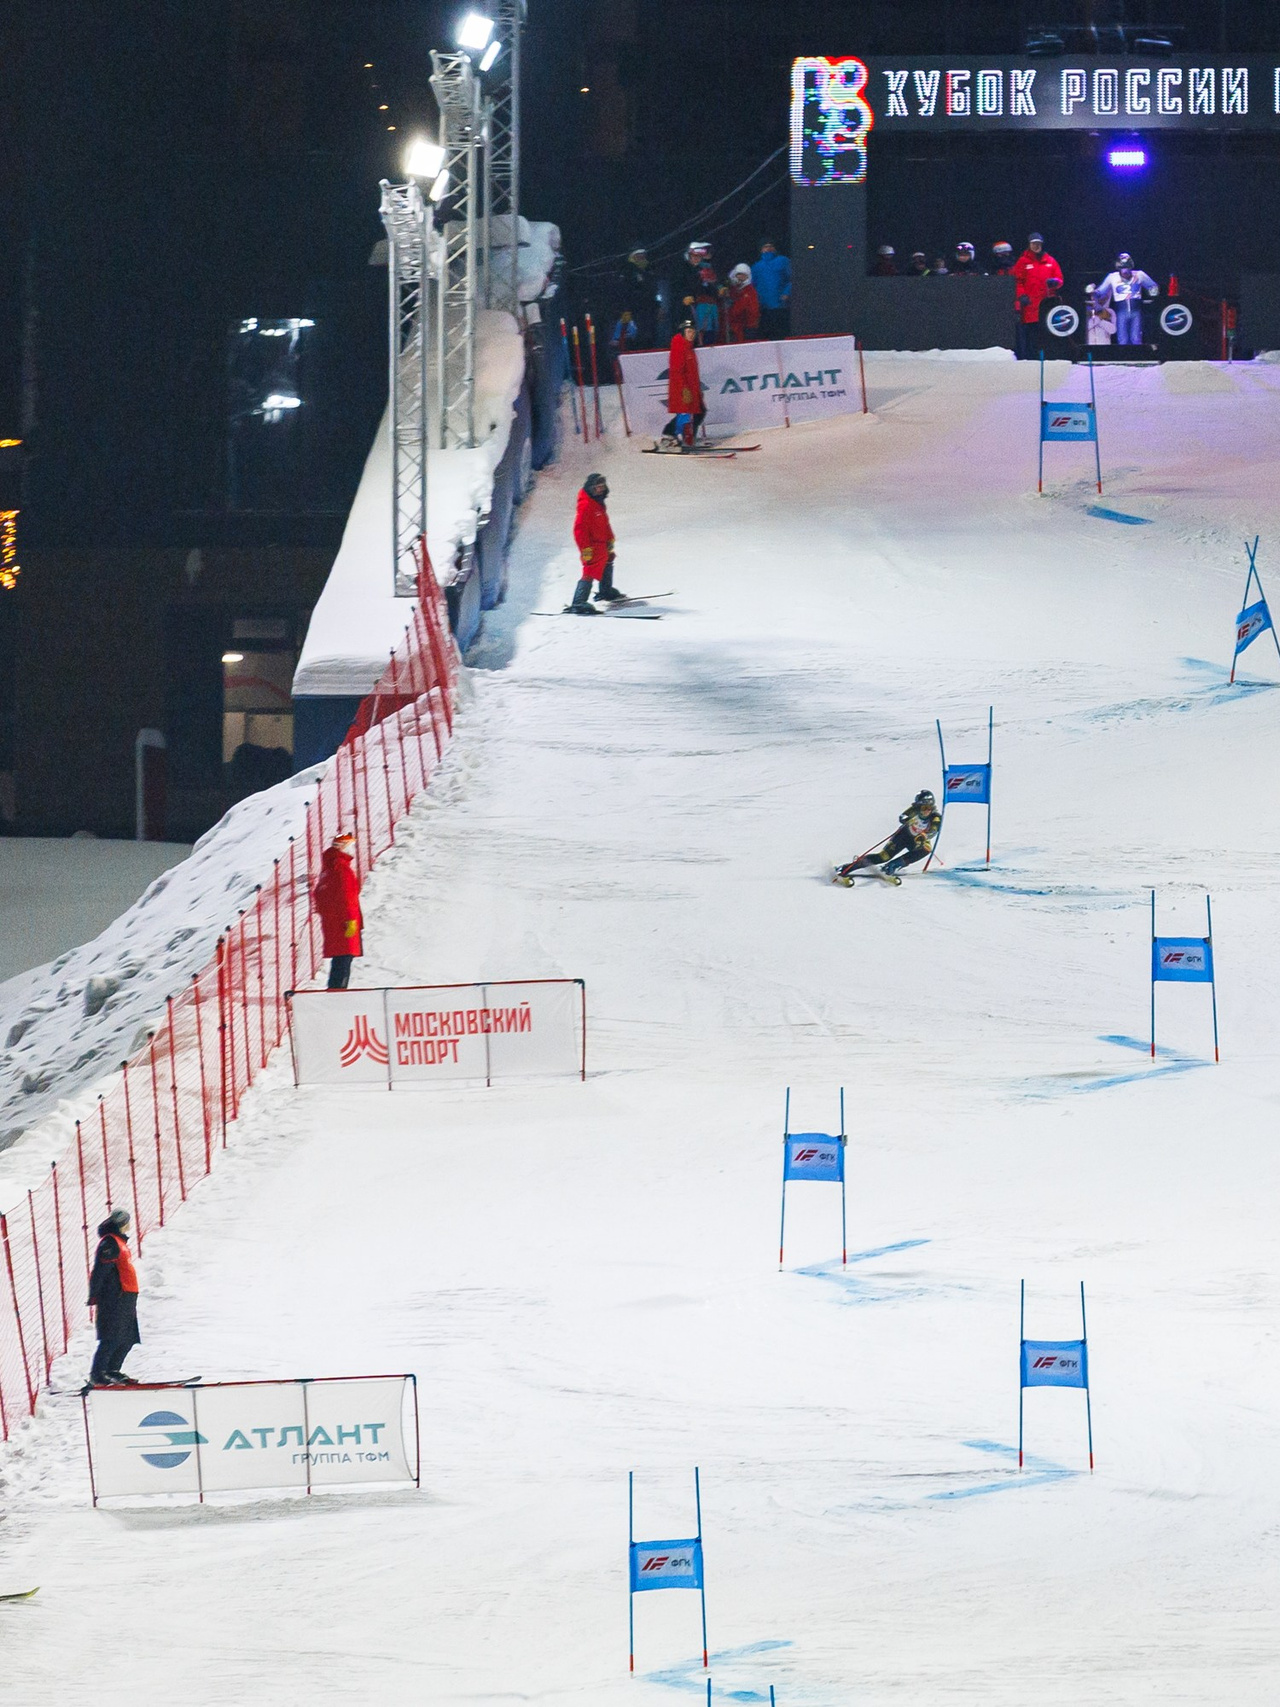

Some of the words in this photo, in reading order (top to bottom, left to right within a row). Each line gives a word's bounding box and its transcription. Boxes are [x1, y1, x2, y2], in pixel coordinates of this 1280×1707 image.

[882, 69, 1037, 117] КУБОК
[1060, 68, 1248, 116] РОССИИ
[719, 369, 842, 394] АТЛАНТ
[394, 1001, 532, 1038] МОСКОВСКИЙ
[396, 1039, 460, 1066] СПОРТ
[222, 1422, 386, 1450] АТЛАНТ
[292, 1452, 352, 1466] ГРУППА
[355, 1451, 390, 1462] ТФМ
